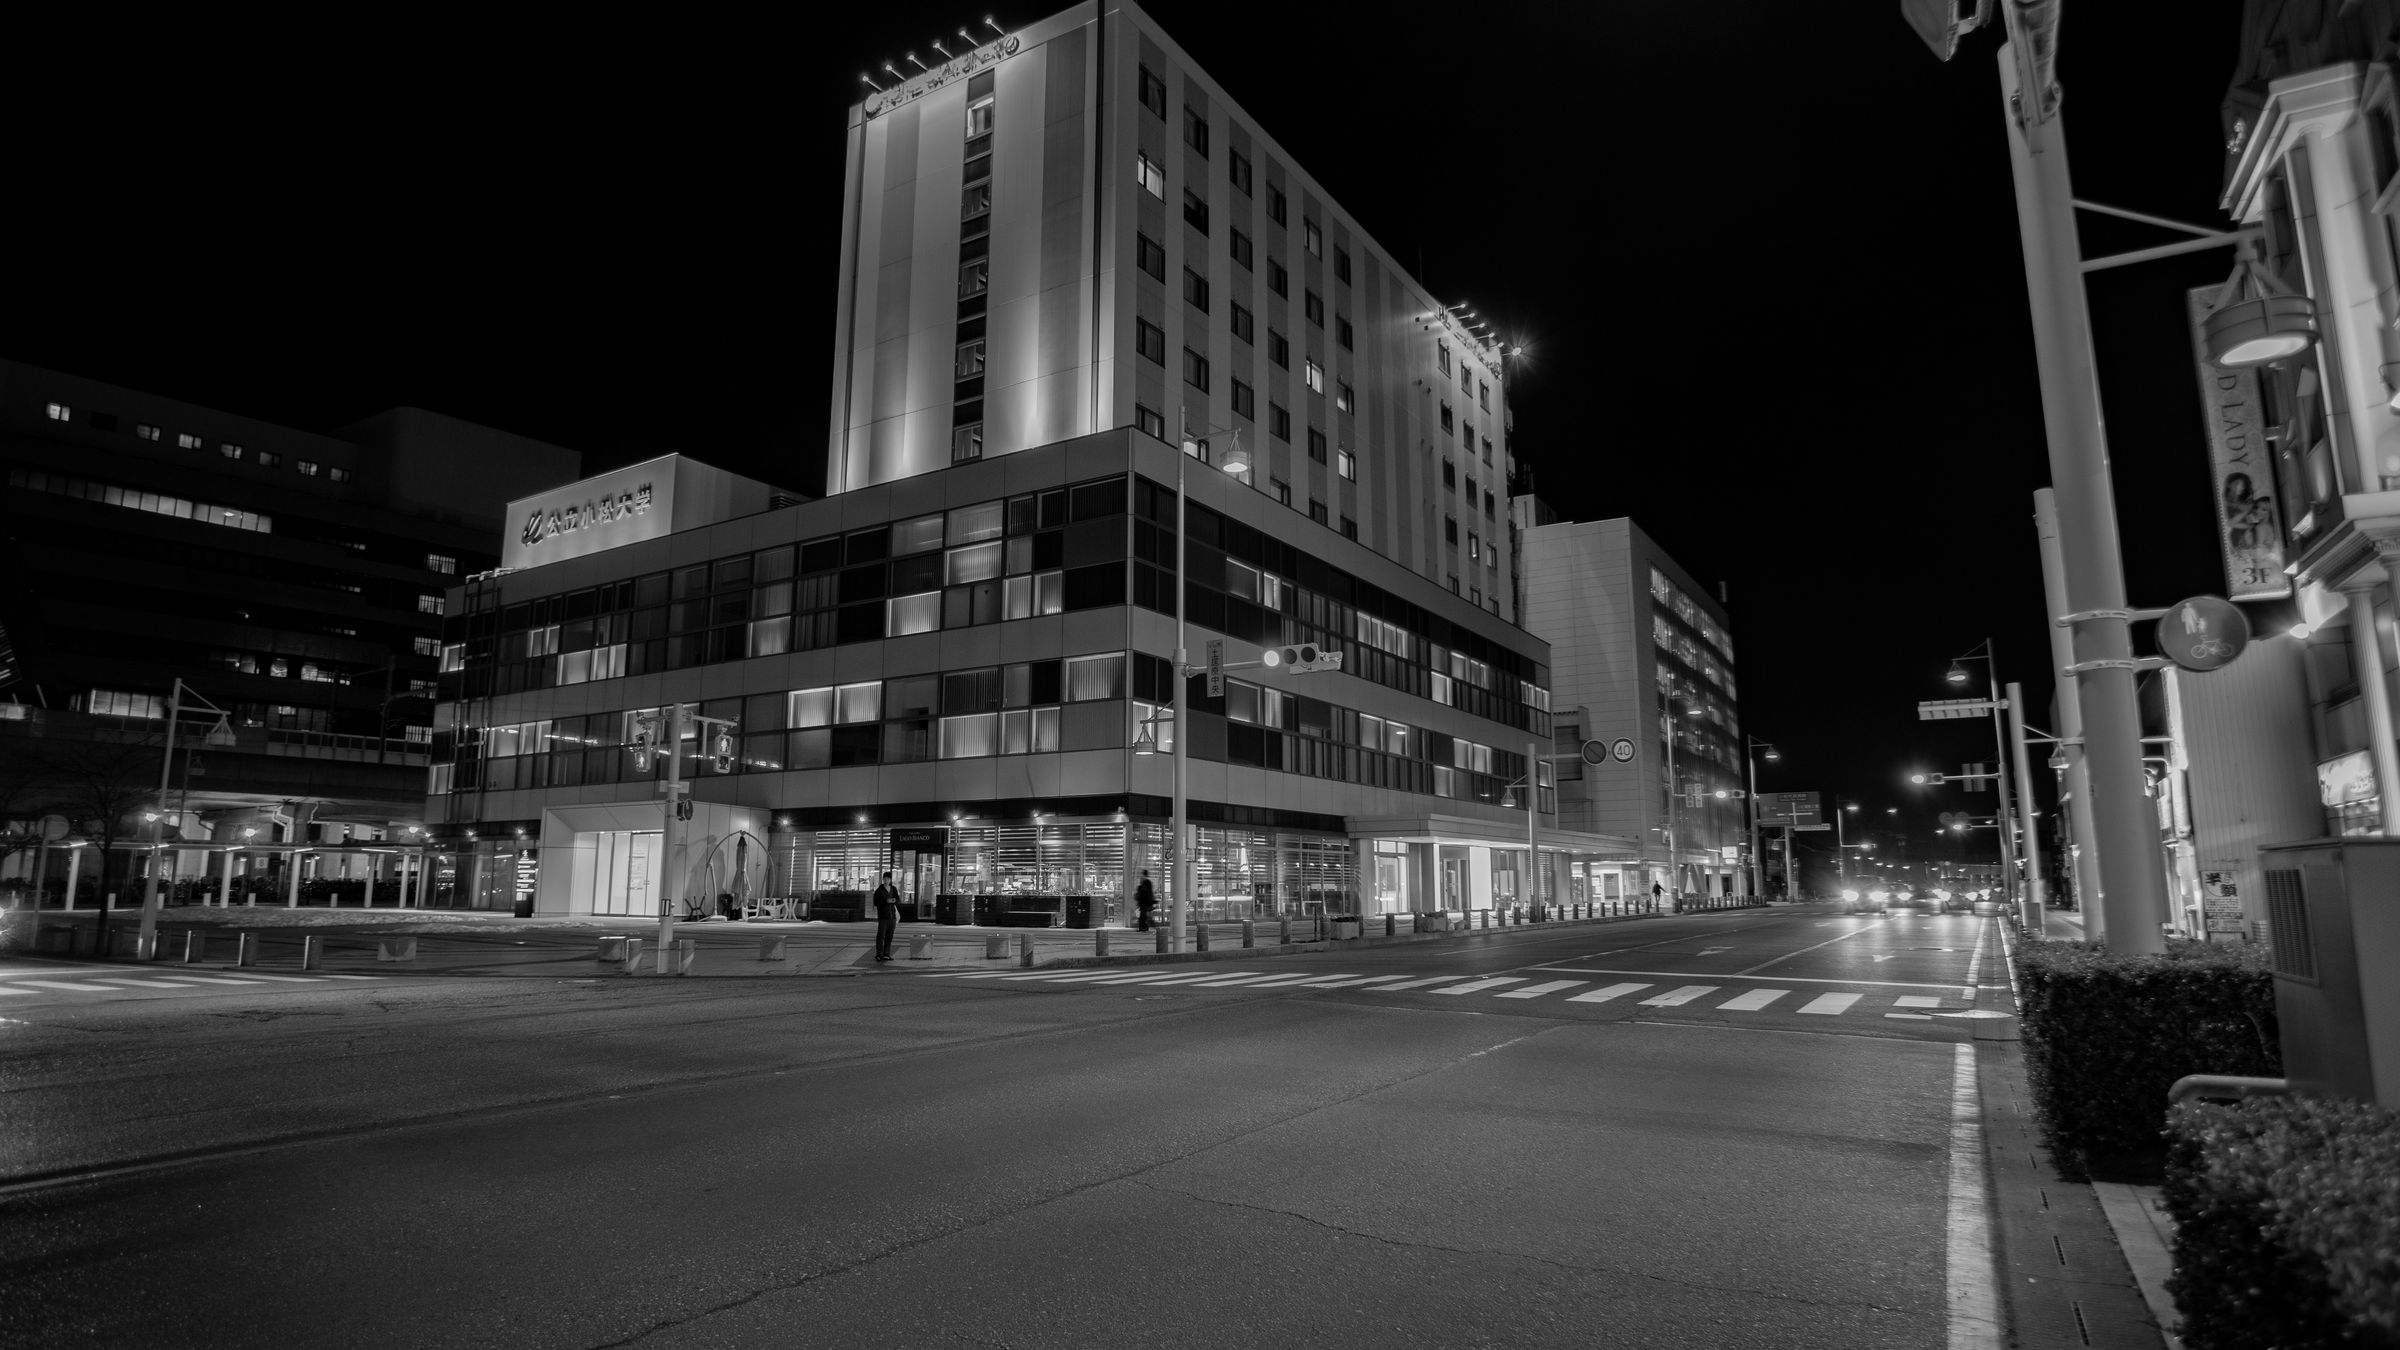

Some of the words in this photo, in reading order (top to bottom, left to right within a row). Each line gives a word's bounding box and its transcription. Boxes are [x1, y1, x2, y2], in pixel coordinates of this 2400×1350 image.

[2221, 402, 2250, 466] LADY
[546, 488, 652, 538] 公立小松大学
[2242, 567, 2271, 585] 3F
[1616, 744, 1631, 756] 40
